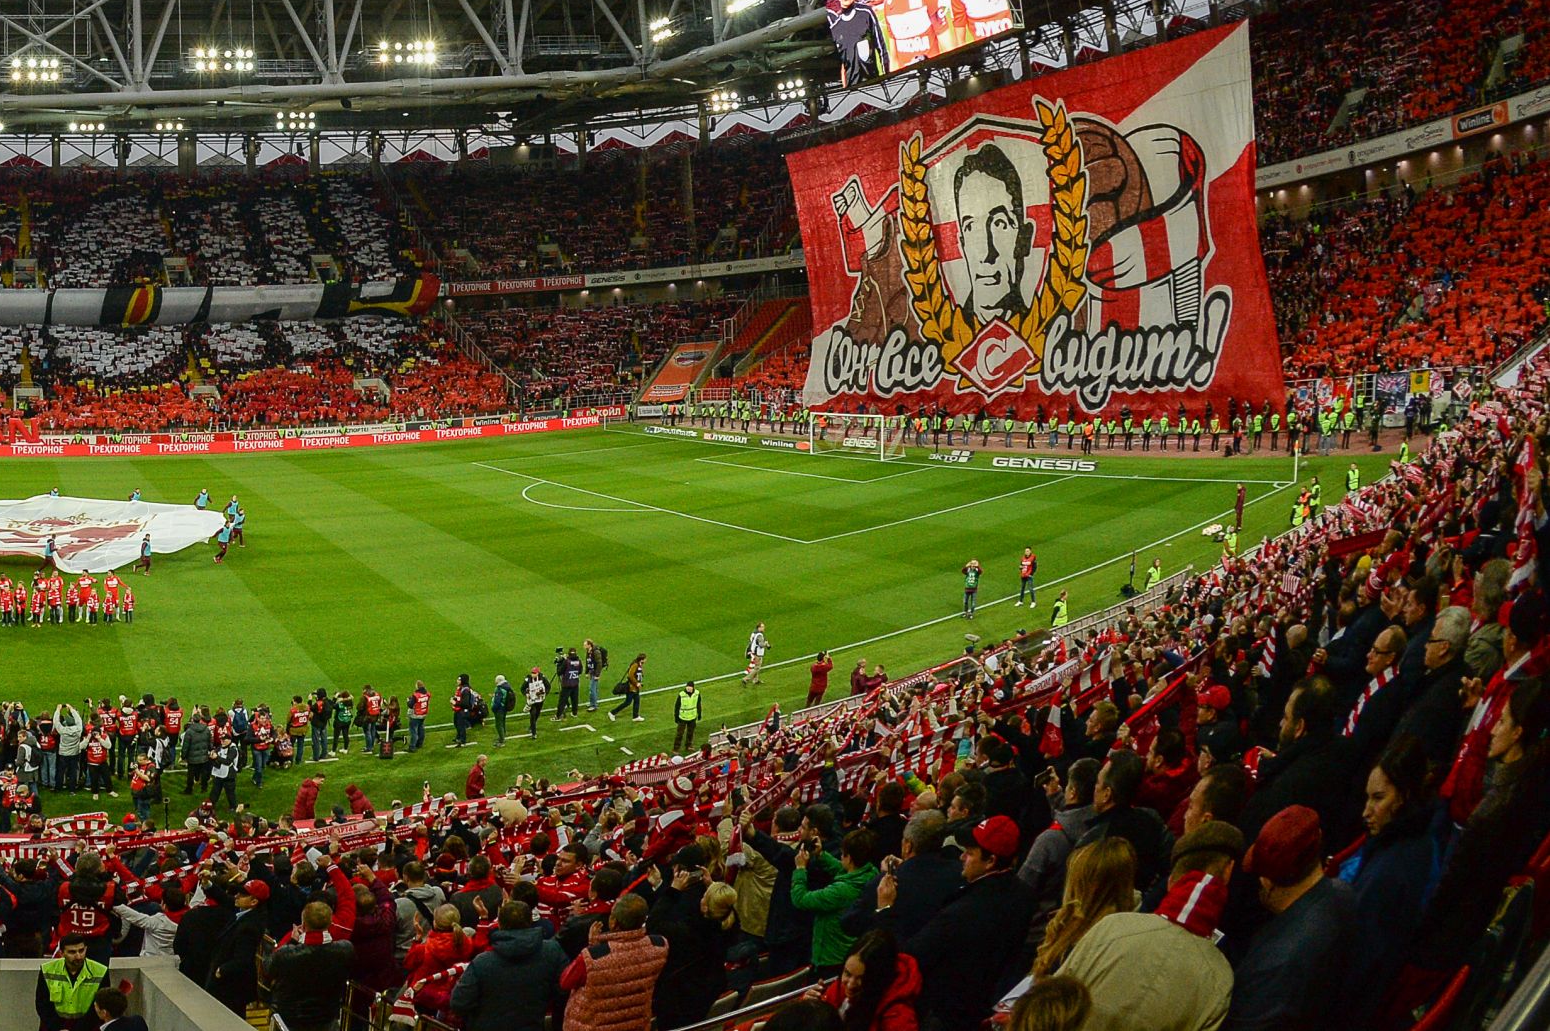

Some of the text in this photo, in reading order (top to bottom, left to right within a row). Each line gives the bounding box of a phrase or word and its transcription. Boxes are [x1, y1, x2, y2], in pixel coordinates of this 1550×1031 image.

[1459, 113, 1491, 130] Winline
[590, 275, 626, 284] GENESIS
[586, 407, 621, 417] ЛКОЙЛ
[475, 418, 500, 426] Winline
[712, 433, 748, 445] ЛУКОЙЛ
[761, 438, 795, 448] Winline
[843, 437, 877, 449] GENESIS
[992, 457, 1096, 472] GENESIS
[92, 746, 102, 755] 32
[70, 910, 95, 928] 19
